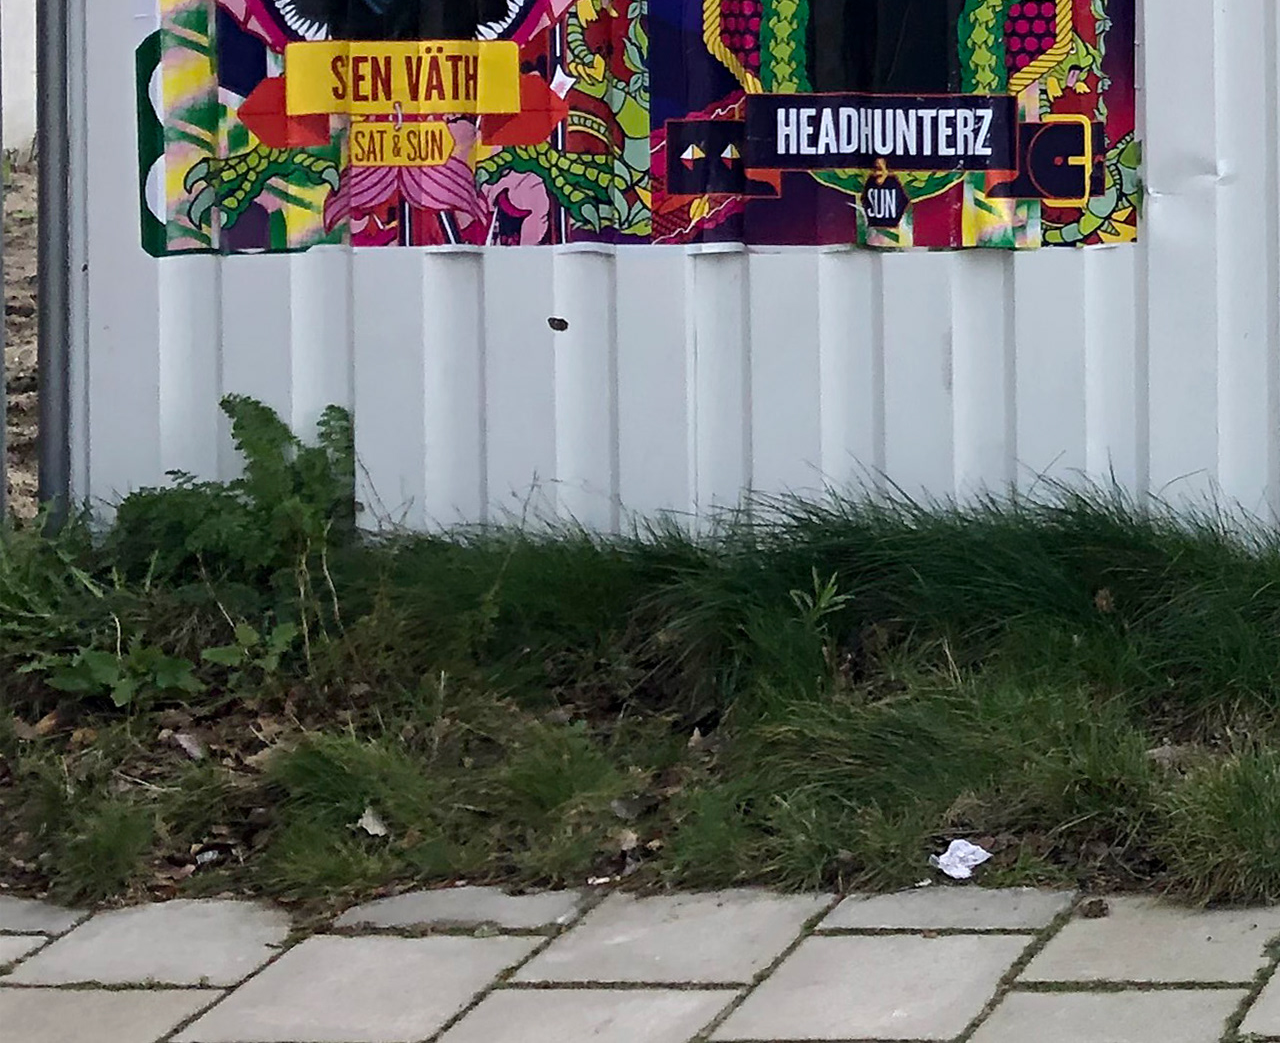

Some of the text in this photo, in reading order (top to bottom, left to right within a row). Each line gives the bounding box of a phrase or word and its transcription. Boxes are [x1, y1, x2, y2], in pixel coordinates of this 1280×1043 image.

[404, 46, 477, 101] VÄTH
[354, 130, 443, 162] SAT & SUN
[776, 107, 993, 156] HEADHUNTERZ
[867, 187, 897, 219] SUN
